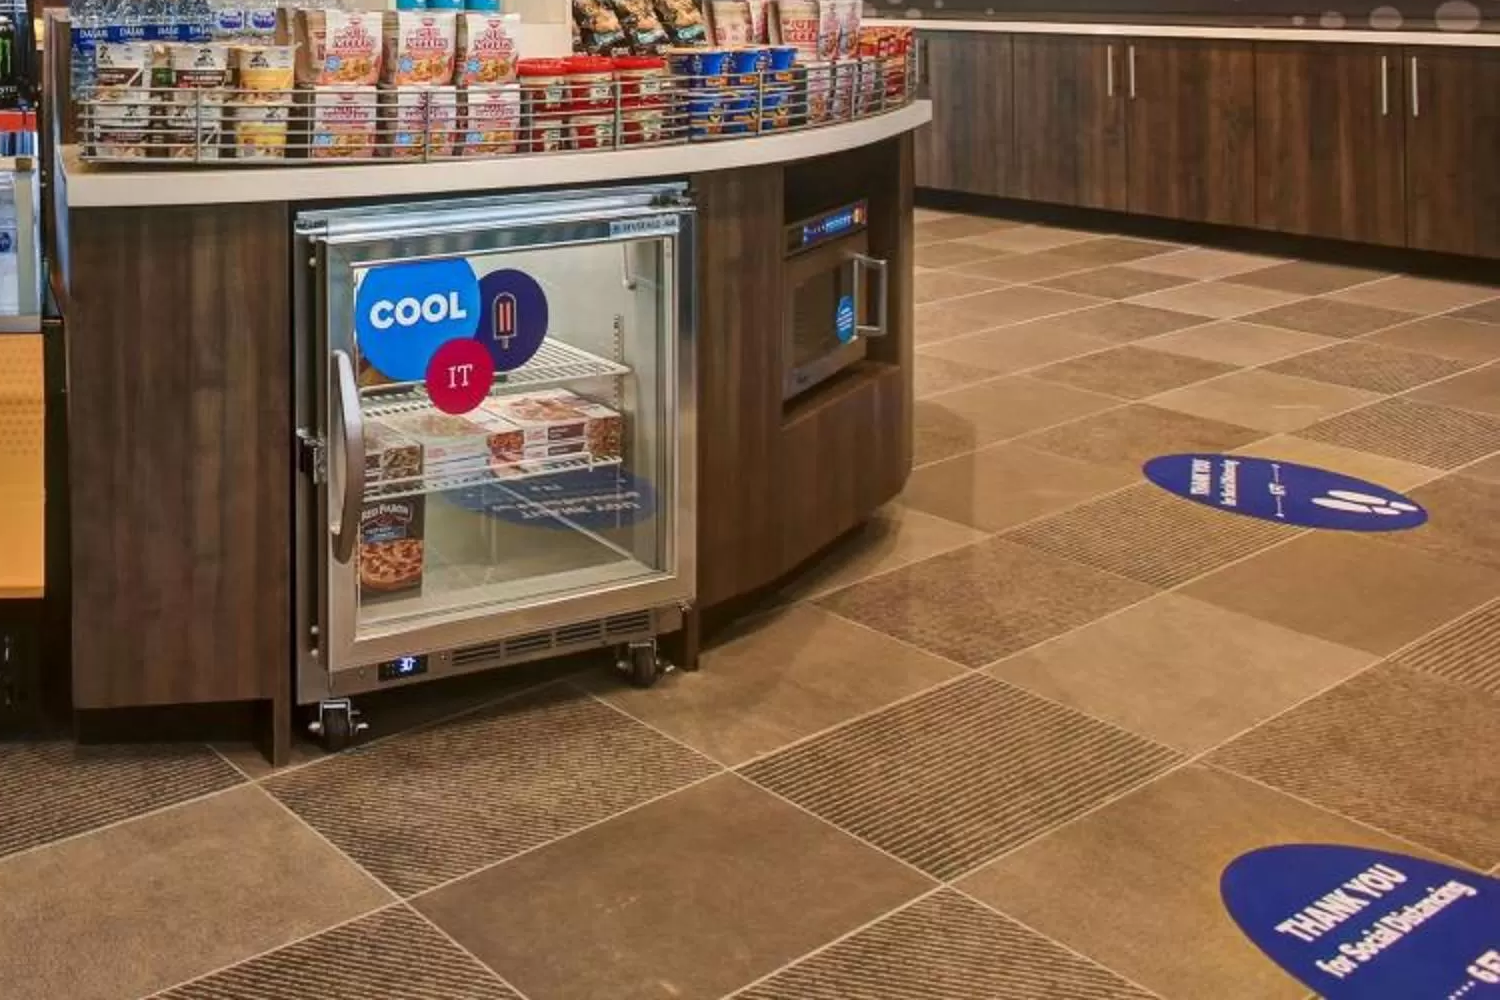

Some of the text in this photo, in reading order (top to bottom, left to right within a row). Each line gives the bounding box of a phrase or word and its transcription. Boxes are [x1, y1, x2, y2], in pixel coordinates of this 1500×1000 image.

[369, 292, 467, 329] COOL
[447, 363, 473, 390] IT
[1273, 863, 1408, 942] THANK YOU
[1315, 880, 1478, 978] for Social Distancing
